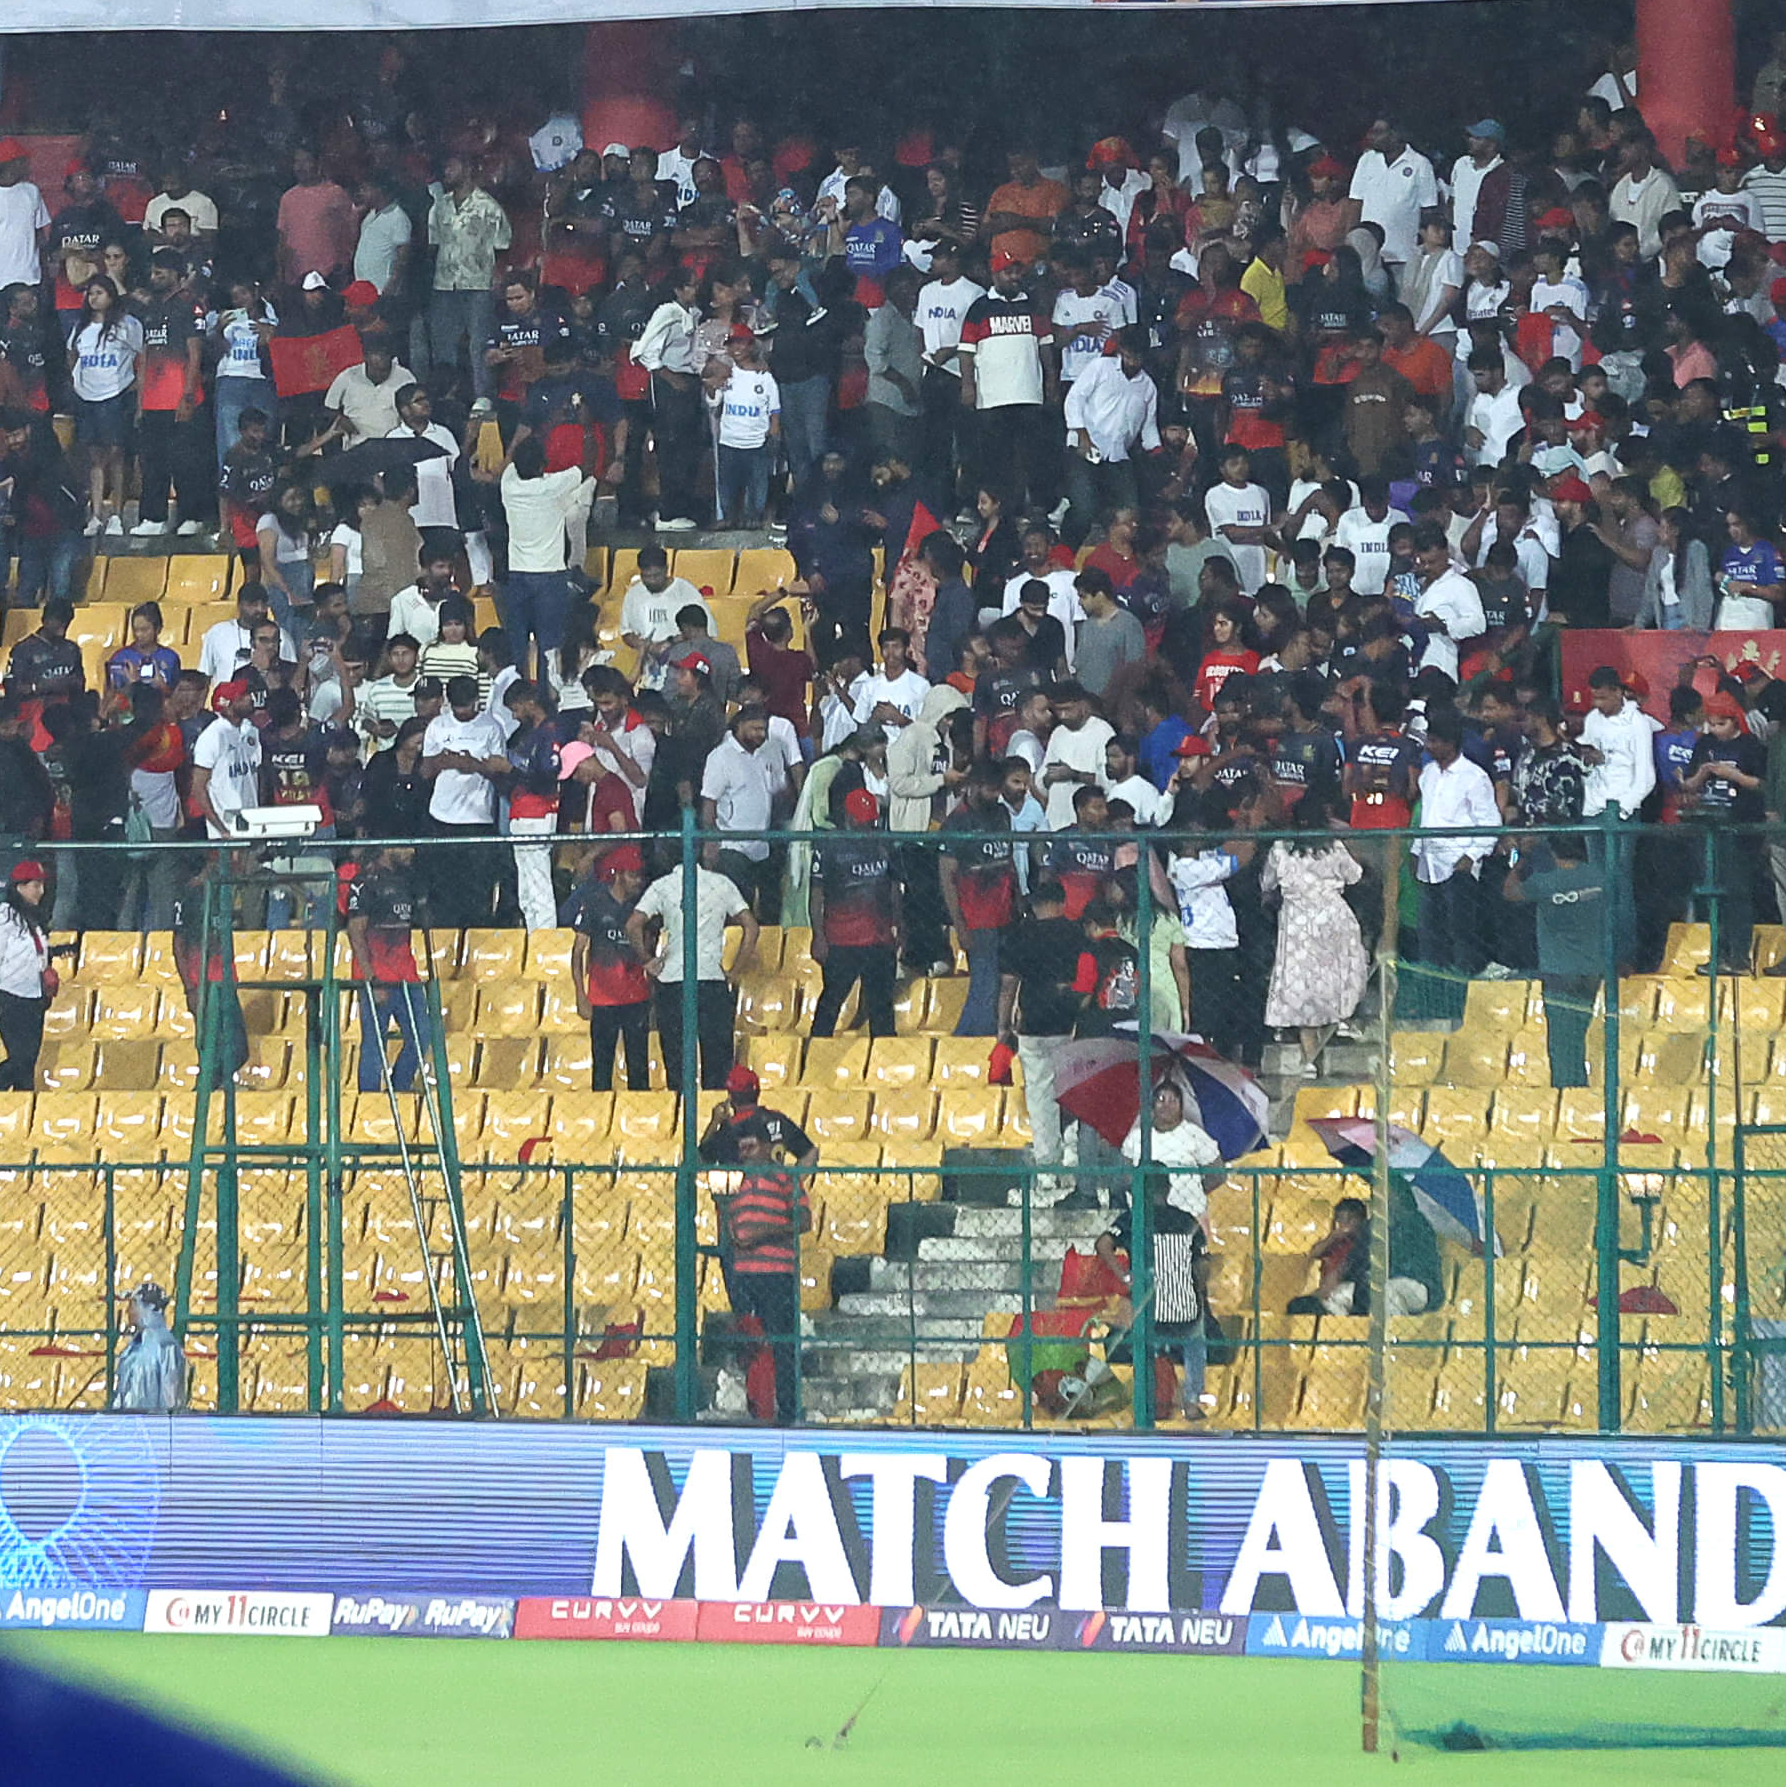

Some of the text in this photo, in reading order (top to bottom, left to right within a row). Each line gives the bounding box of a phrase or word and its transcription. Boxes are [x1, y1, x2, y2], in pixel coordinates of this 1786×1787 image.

[272, 754, 305, 765] KEI
[1360, 744, 1399, 758] KEI
[592, 1448, 1172, 1611] MATCH
[5, 1589, 125, 1625] AngelOne
[335, 1599, 410, 1632] RuPay
[424, 1601, 503, 1634] RuPay
[551, 1601, 661, 1618] CURVV
[734, 1604, 844, 1622] CURVV
[929, 1612, 1050, 1640] TATA NEU
[1111, 1618, 1233, 1645] TATA NEU
[1291, 1617, 1410, 1656] Angelne
[1472, 1623, 1587, 1659] AngelOne
